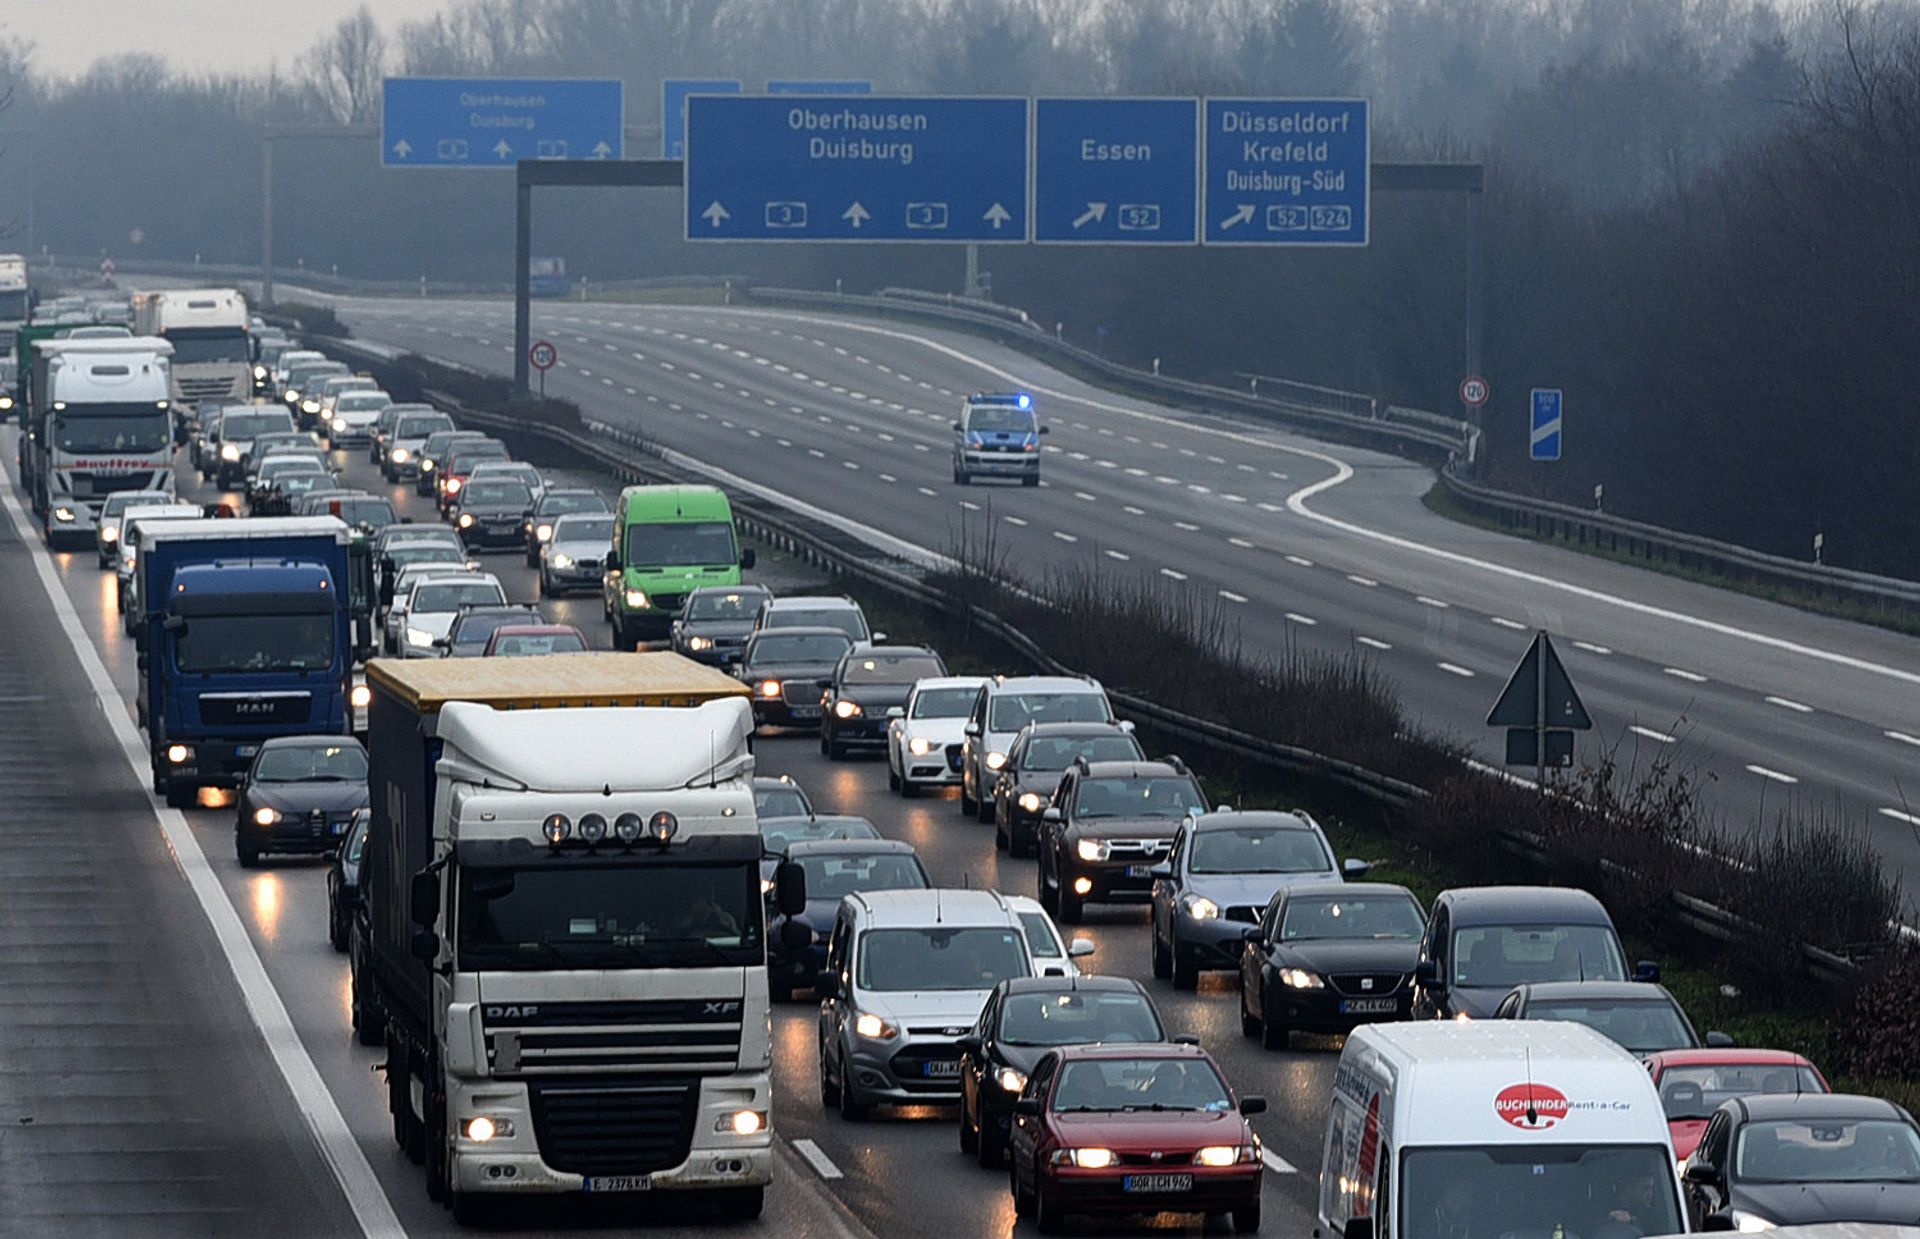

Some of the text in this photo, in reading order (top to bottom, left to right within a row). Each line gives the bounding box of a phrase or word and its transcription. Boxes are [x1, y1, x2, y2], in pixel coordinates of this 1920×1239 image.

[788, 109, 928, 131] Oberhausen
[1222, 111, 1350, 133] Düsseldorf
[809, 138, 914, 164] Duisburg
[1081, 140, 1152, 161] Essen
[1243, 140, 1328, 162] Krefeld
[1226, 169, 1345, 195] Duisburg-Süd
[1129, 210, 1150, 226] 52
[1277, 210, 1298, 226] 52
[1315, 210, 1346, 226] 524
[236, 703, 275, 714] MAN
[487, 1006, 538, 1018] DAF
[702, 1002, 740, 1014] XF
